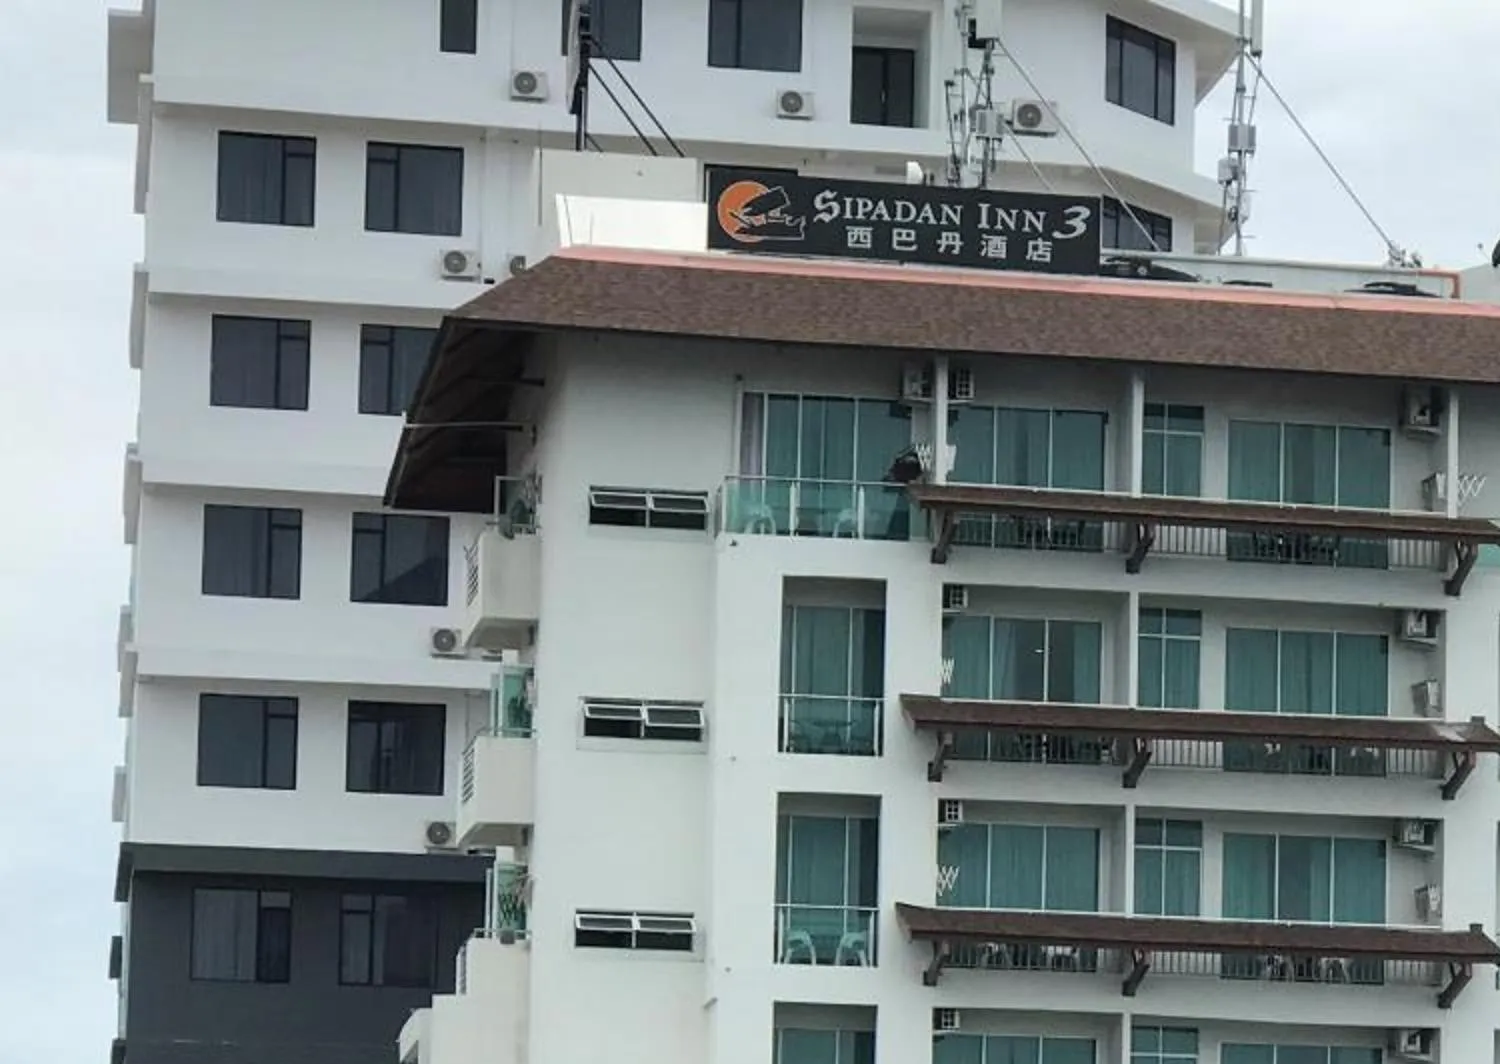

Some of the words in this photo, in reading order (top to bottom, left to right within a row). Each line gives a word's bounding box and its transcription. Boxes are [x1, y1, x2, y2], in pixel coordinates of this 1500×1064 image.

[812, 189, 964, 226] SIPADAN
[977, 202, 1048, 233] INN
[1052, 204, 1092, 240] 3
[844, 225, 1054, 264] 西巴丹酒店
